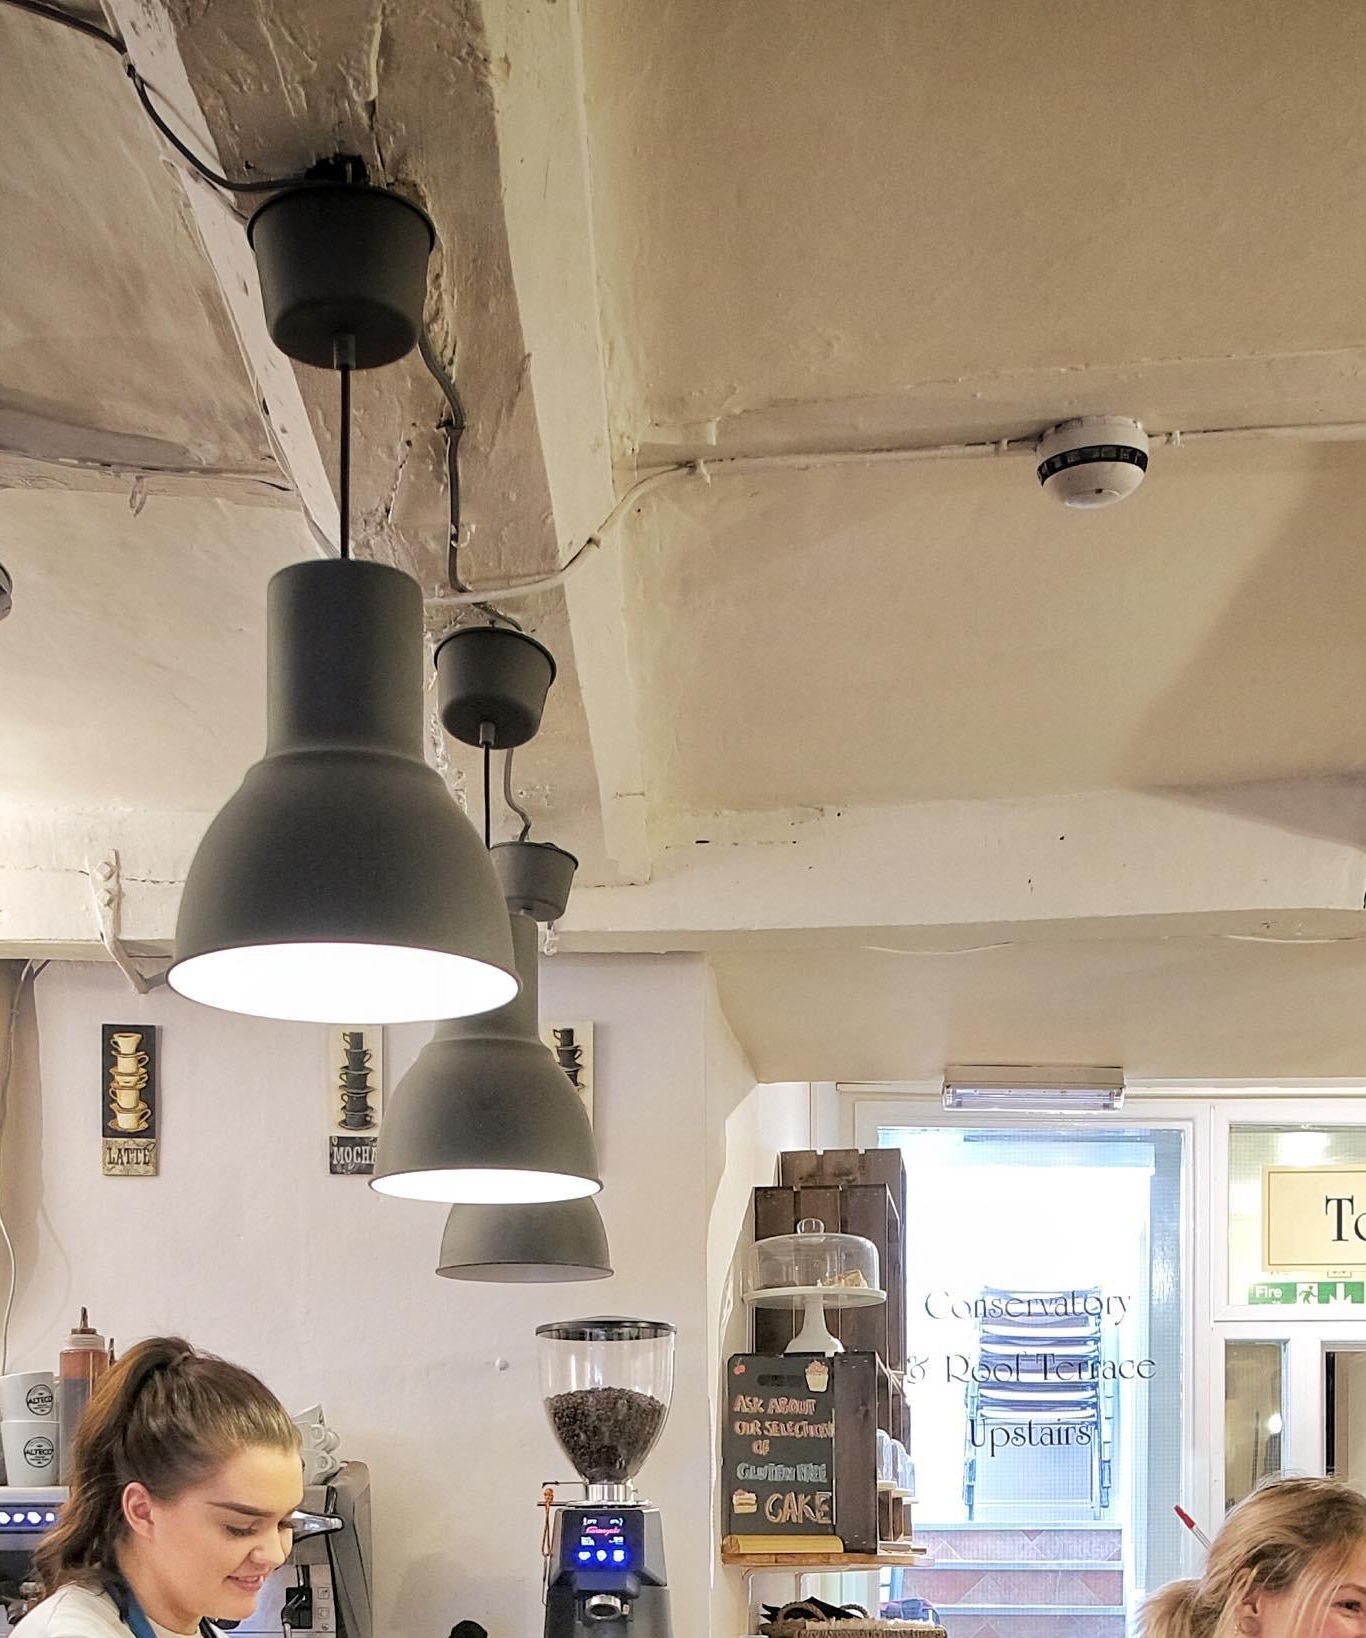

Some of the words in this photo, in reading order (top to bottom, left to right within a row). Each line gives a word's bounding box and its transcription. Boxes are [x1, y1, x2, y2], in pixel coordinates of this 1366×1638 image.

[106, 1146, 153, 1167] LATTE
[924, 1290, 1132, 1326] Conservatory
[946, 1350, 1027, 1384] Roof
[1035, 1353, 1157, 1382] Terrace
[767, 1397, 817, 1415] ABOUT
[969, 1418, 1092, 1458] Upstairs
[737, 1462, 796, 1482] GLUTEN
[796, 1461, 828, 1483] FREE
[764, 1491, 833, 1525] CAKE
